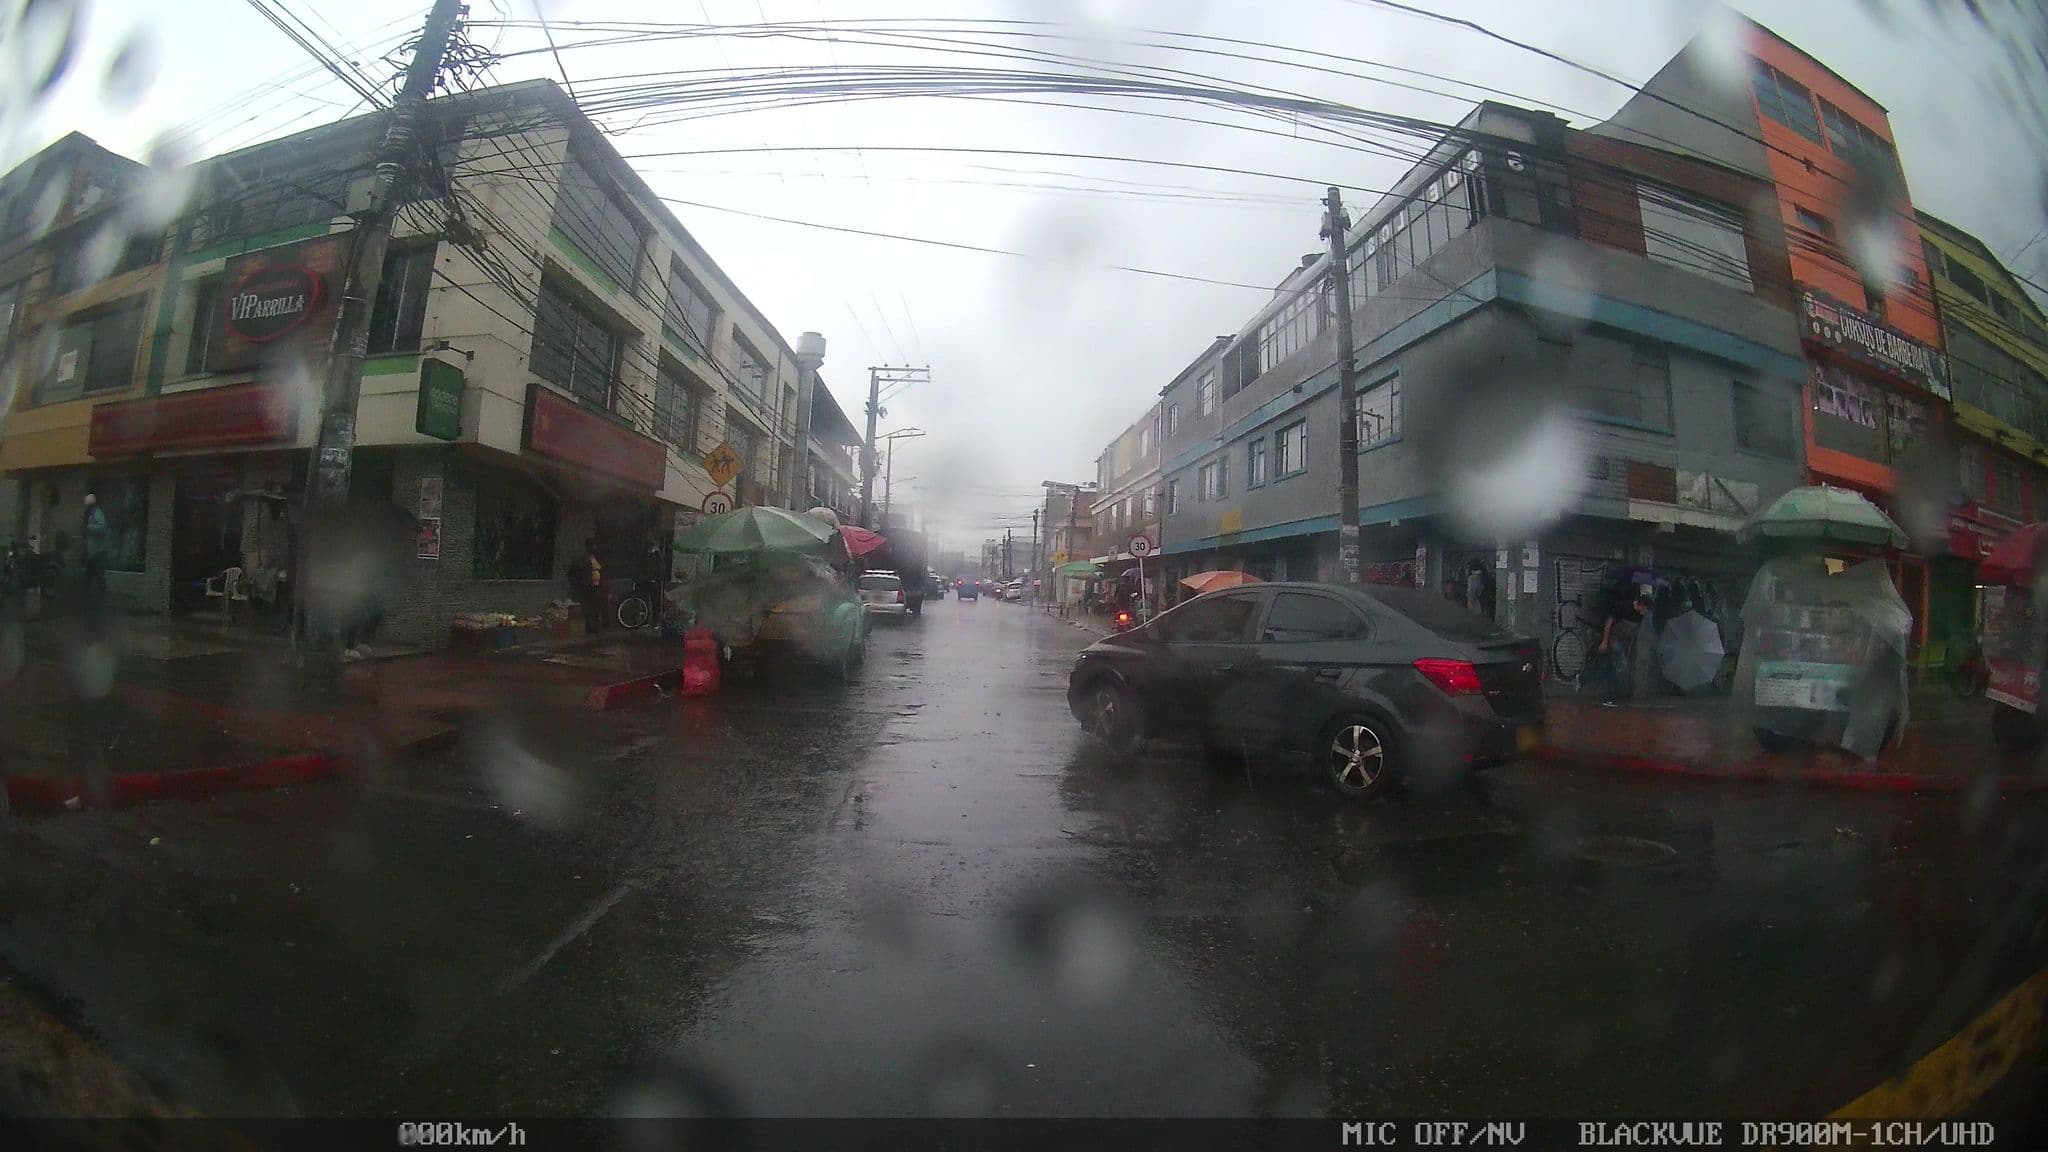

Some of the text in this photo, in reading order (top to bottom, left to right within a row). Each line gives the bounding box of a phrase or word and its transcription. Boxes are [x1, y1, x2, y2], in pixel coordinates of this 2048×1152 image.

[1840, 314, 1875, 349] CURSOS
[1874, 328, 1888, 356] DE
[710, 502, 725, 514] 30
[1135, 542, 1145, 551] 30
